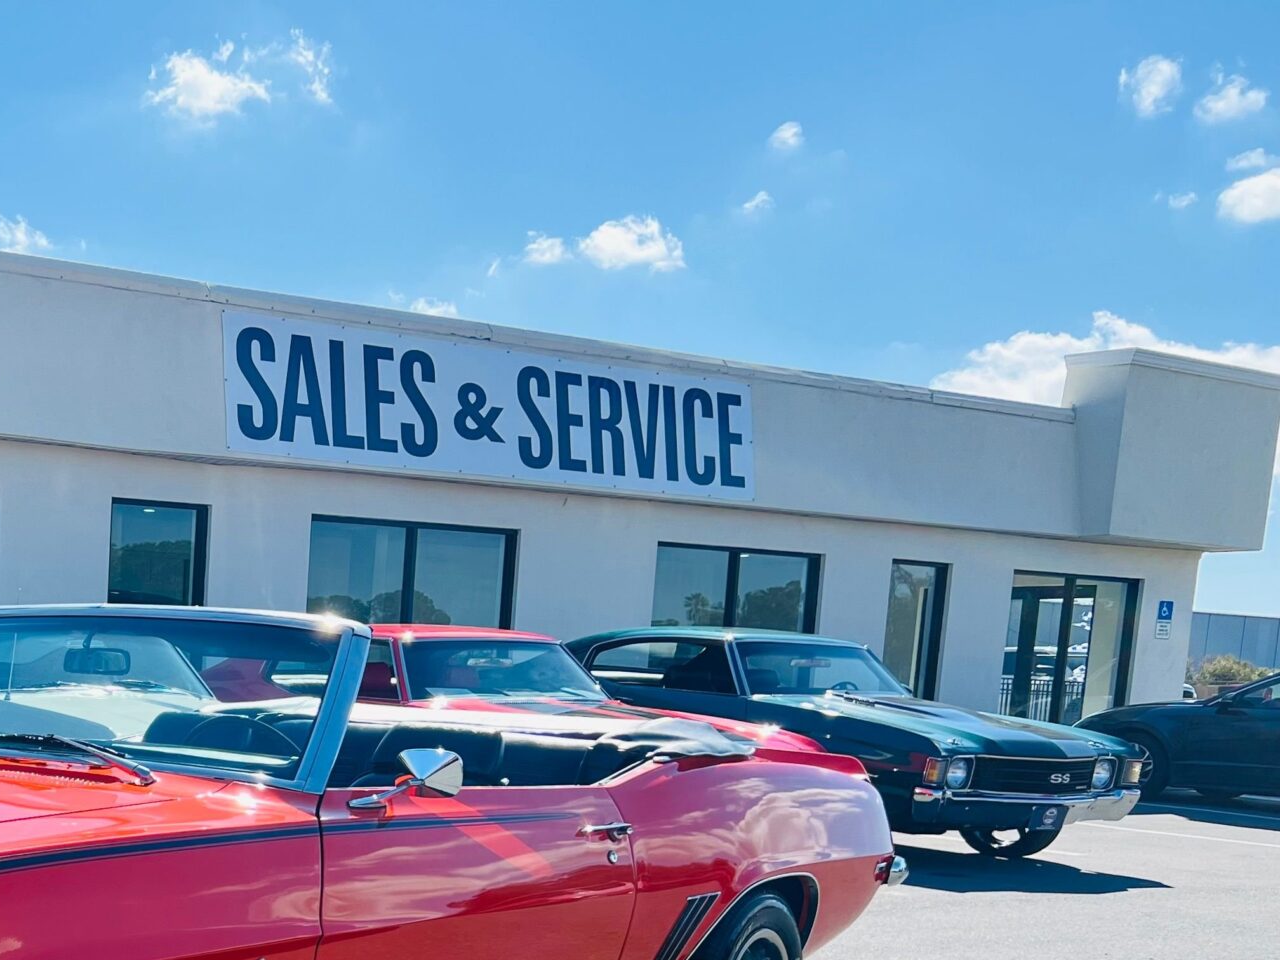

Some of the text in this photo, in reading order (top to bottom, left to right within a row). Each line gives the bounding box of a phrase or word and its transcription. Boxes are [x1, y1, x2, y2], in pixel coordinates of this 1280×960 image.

[235, 326, 746, 488] SALES & SERVICE
[1050, 773, 1071, 783] SS
